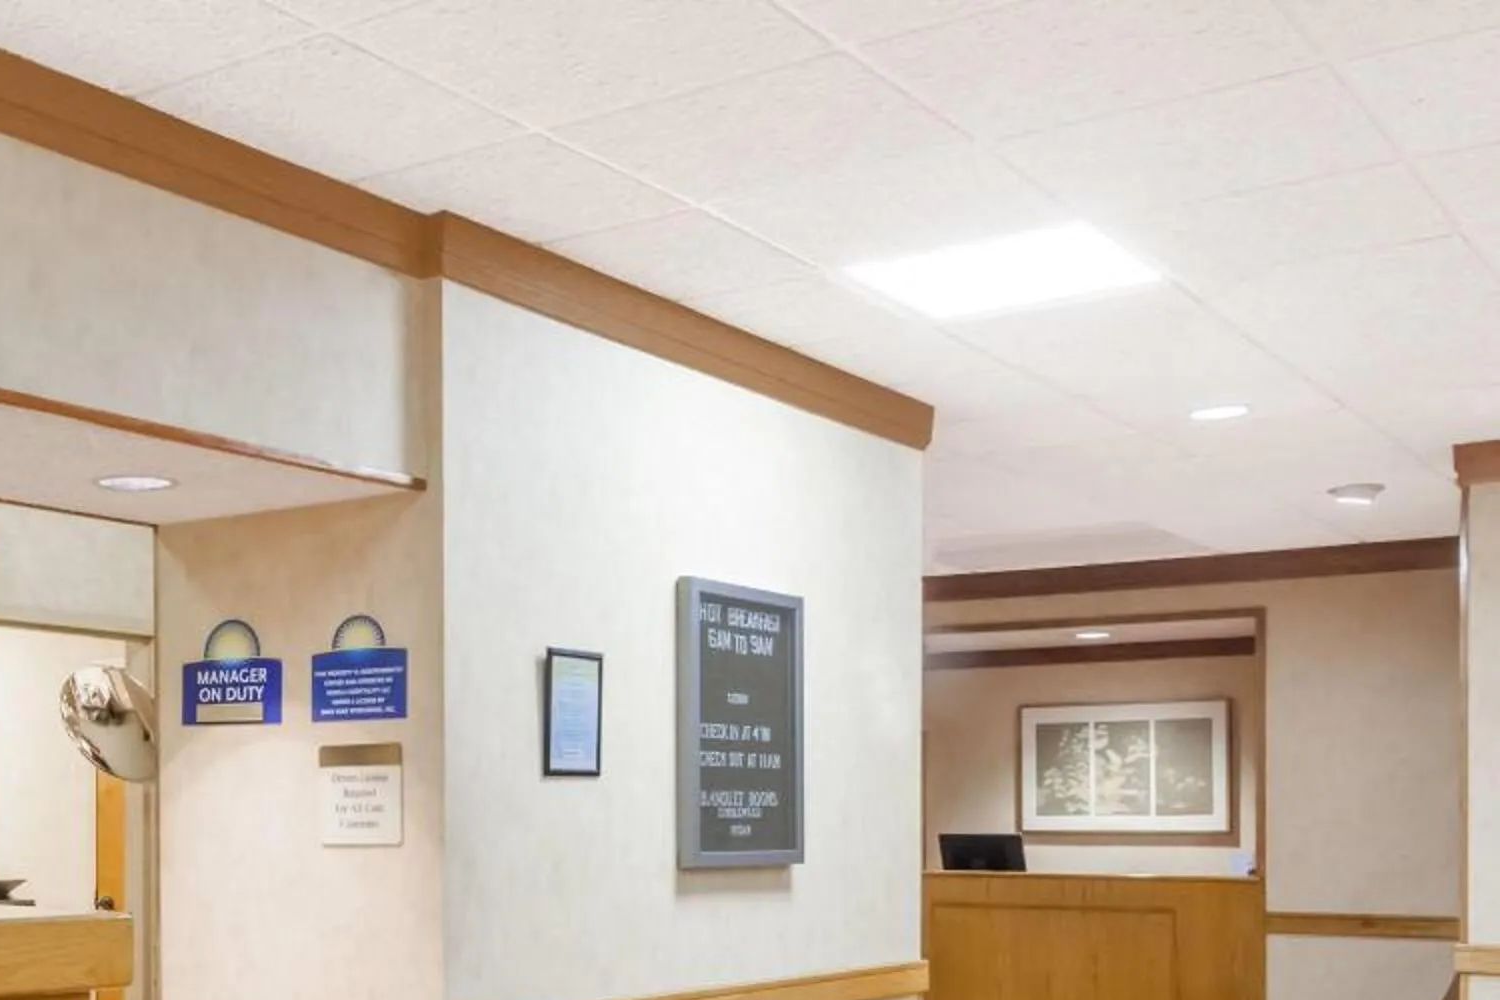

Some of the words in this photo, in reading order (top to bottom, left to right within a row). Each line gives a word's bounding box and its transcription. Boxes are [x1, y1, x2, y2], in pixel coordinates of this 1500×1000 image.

[699, 602, 721, 623] HOT
[707, 627, 732, 651] 6AM
[734, 633, 749, 656] TO
[196, 667, 268, 686] MANAGER
[199, 687, 223, 703] ON
[225, 685, 265, 702] DUTY
